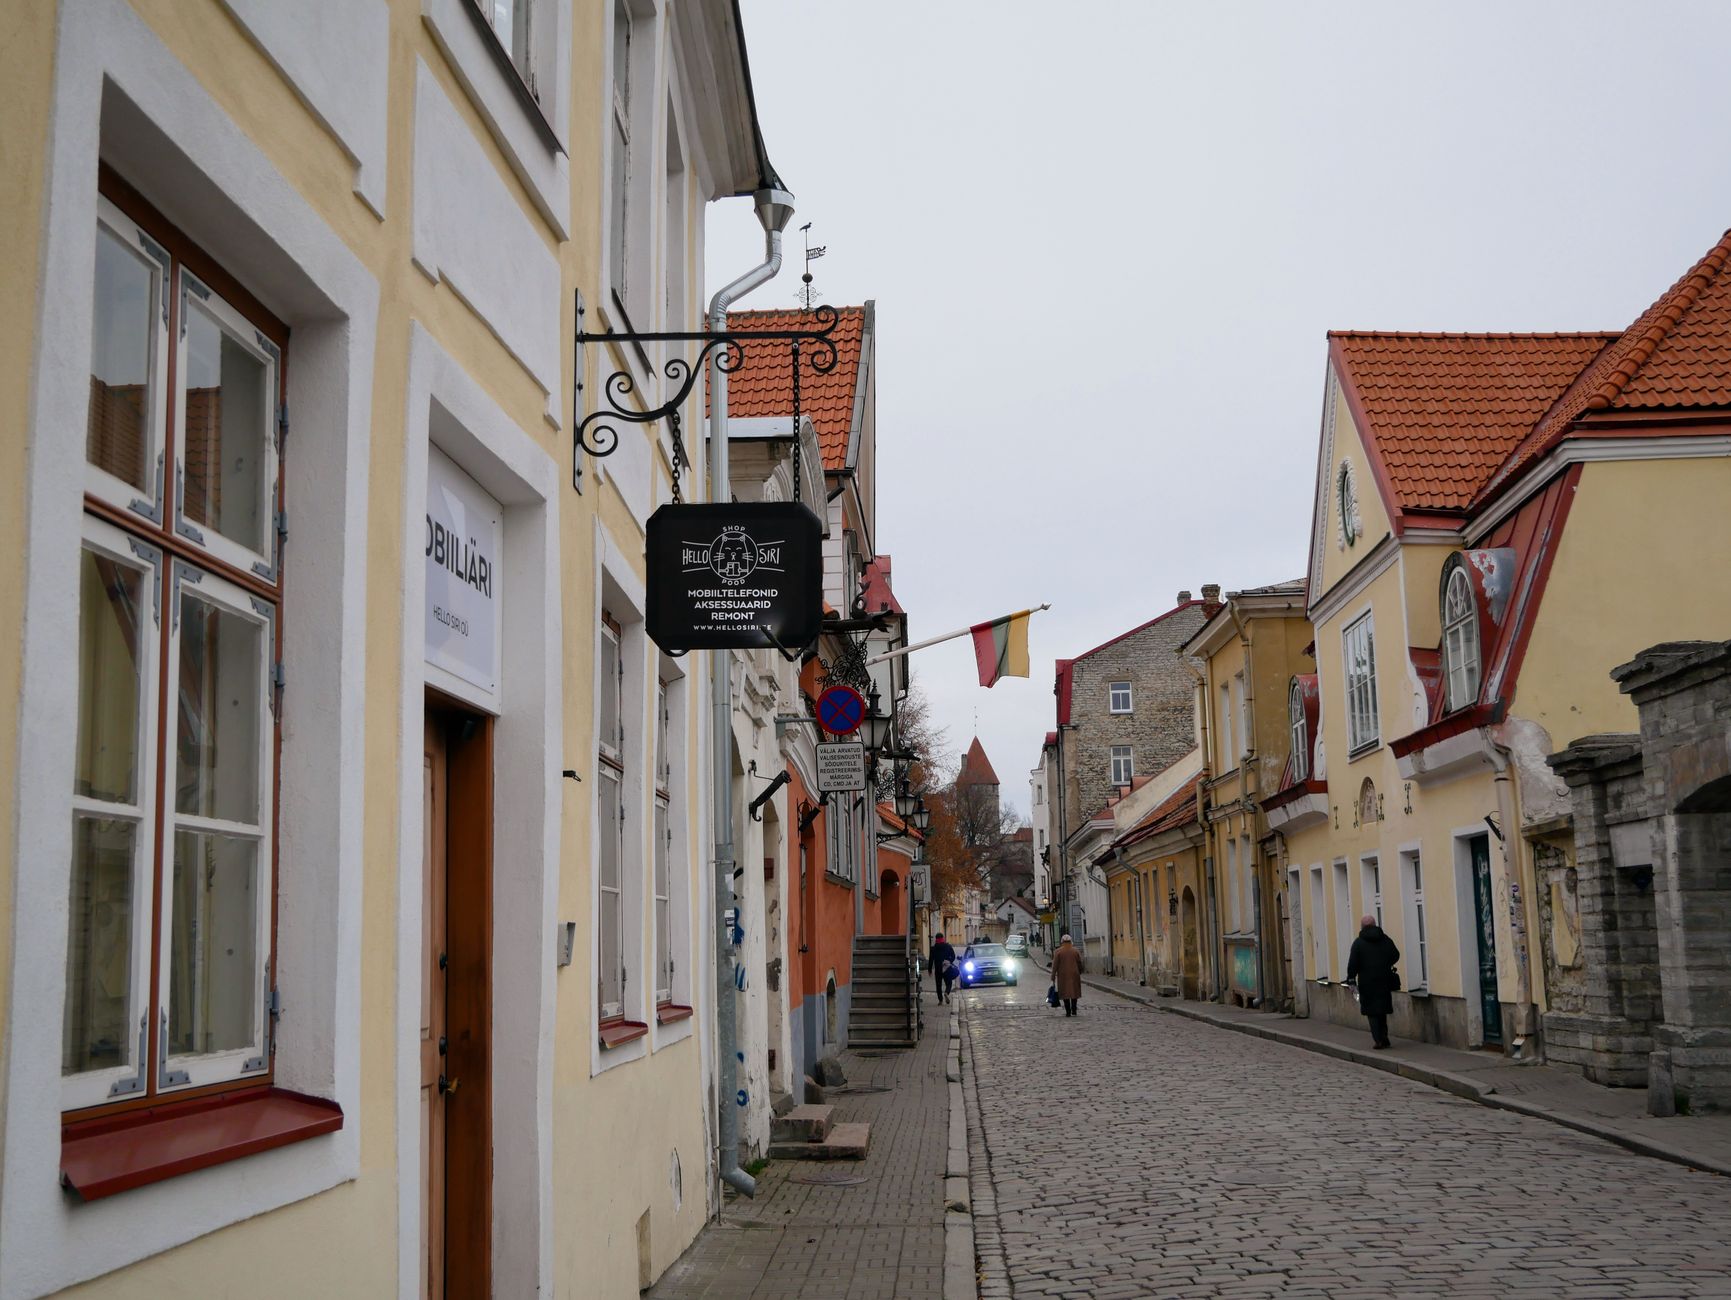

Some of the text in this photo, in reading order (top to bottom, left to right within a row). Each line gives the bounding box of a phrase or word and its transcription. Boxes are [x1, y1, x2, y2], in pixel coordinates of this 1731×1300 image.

[682, 547, 780, 565] HELLO SIRI
[721, 578, 746, 586] POOD
[687, 589, 778, 598] MOBIILTELEFONID
[694, 600, 772, 609] AKSESSUAARID
[433, 604, 450, 626] HELLO
[451, 615, 460, 633] SIRI
[711, 611, 755, 621] REMONT
